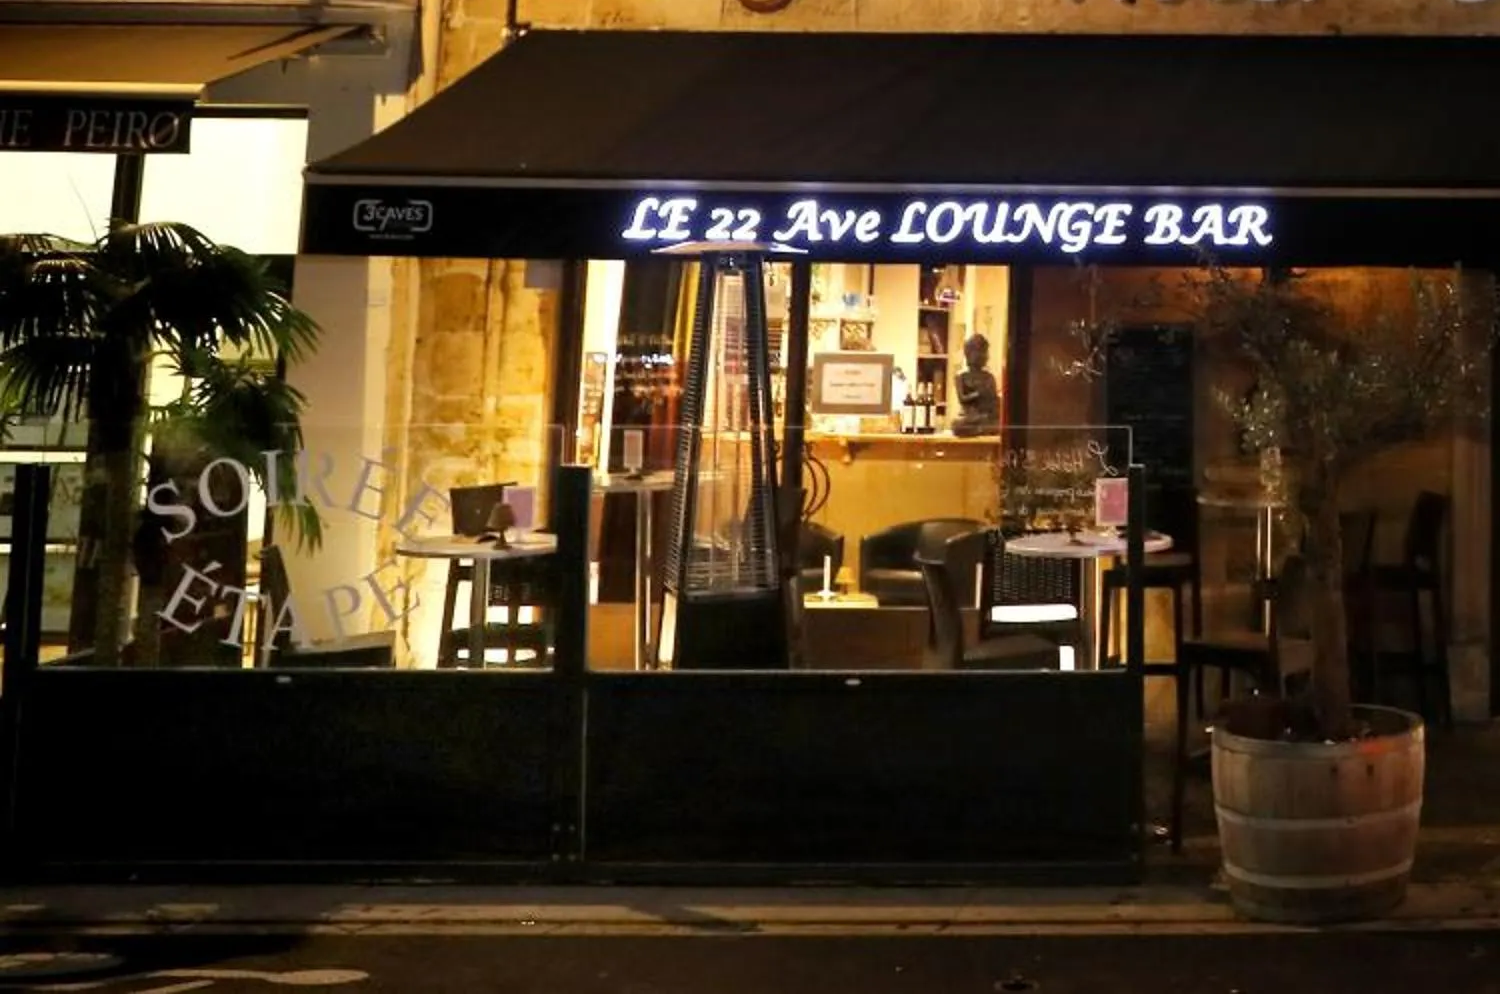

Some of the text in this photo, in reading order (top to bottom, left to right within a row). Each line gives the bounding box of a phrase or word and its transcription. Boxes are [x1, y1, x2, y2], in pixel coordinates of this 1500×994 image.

[622, 197, 1274, 253] LE 22 Ave LOUNGE BAR
[154, 560, 421, 651] ÉTAPE
